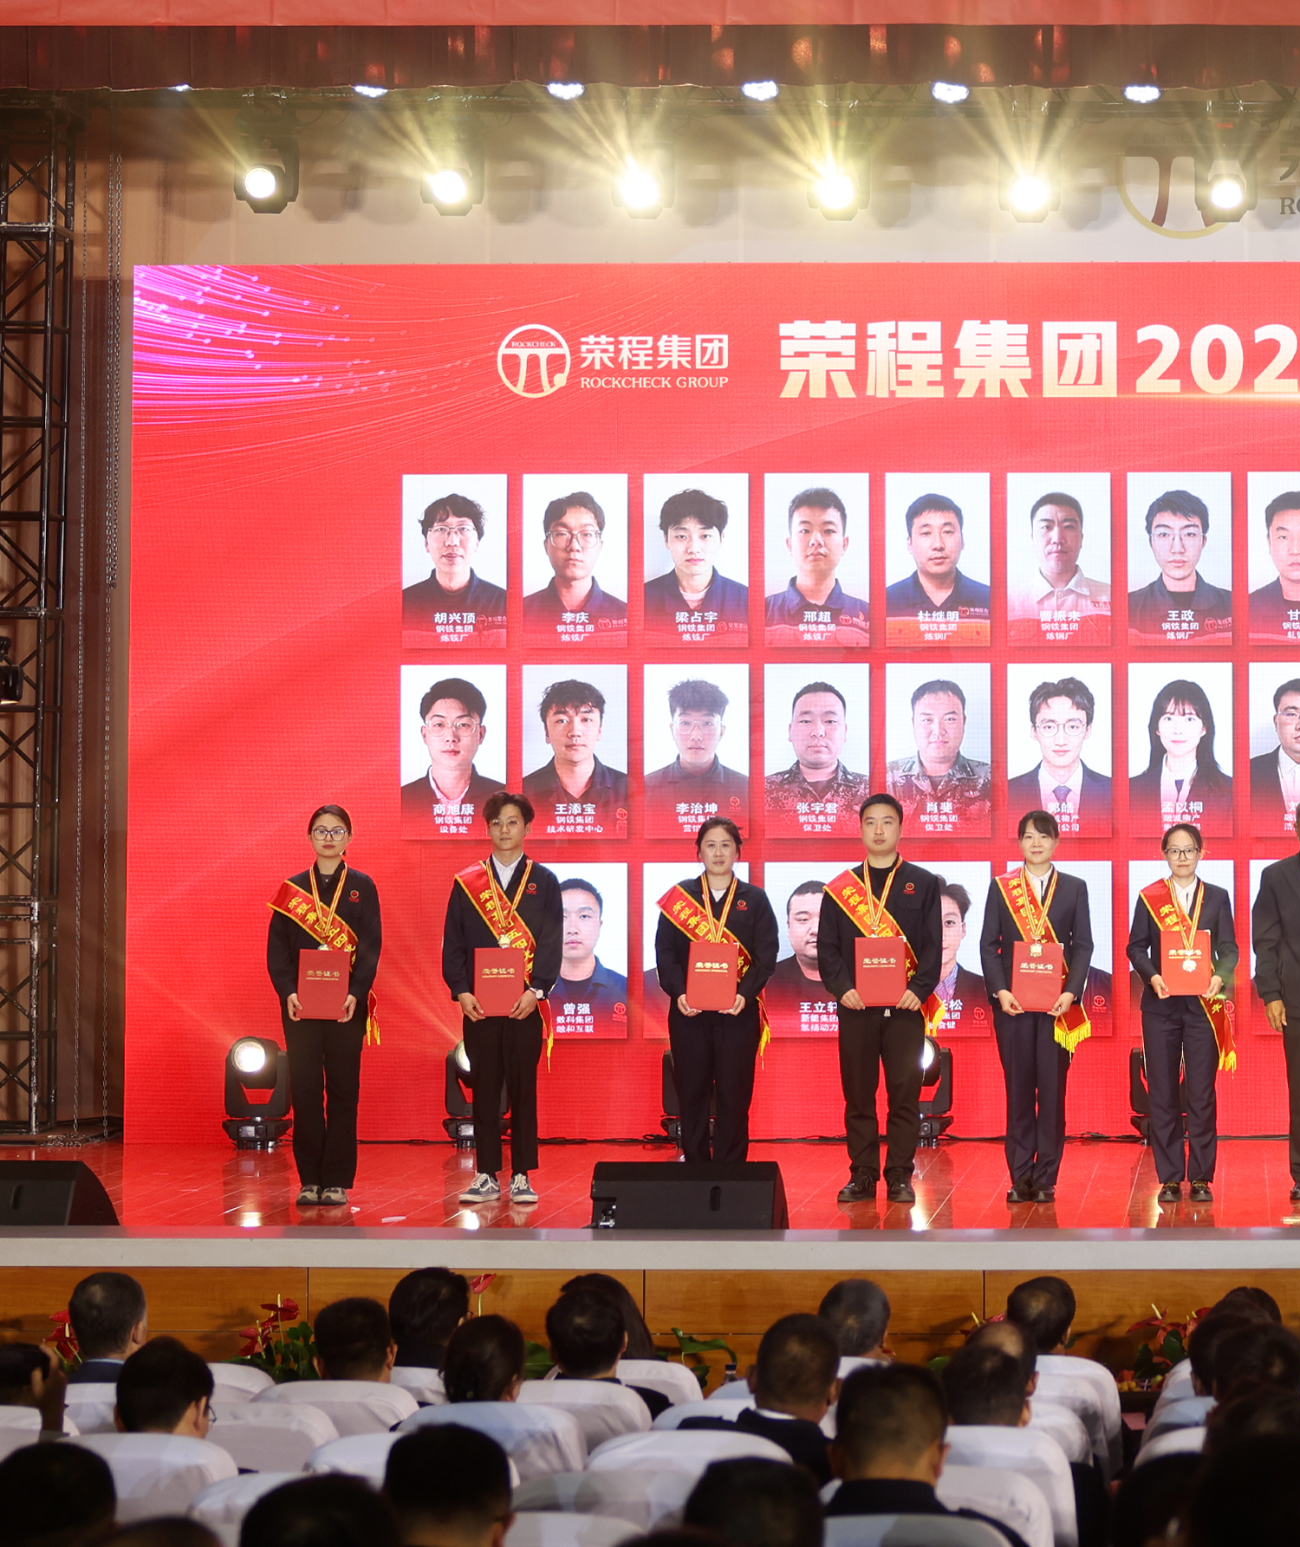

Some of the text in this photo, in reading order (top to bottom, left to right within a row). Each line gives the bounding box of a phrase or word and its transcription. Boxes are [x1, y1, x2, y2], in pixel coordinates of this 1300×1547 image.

[580, 334, 729, 370] 荣程集团
[580, 376, 729, 388] ROCKCHECK GROUP
[434, 614, 475, 625] 胡兴顶
[562, 612, 589, 624] 李庆
[1167, 610, 1194, 621] 王政
[436, 625, 473, 634] 钢铁集团
[557, 624, 594, 633] 钢铁集团
[678, 623, 716, 632] 钢铁集团
[800, 623, 836, 632] 钢铁集团
[920, 622, 958, 631] 钢铁集团
[1041, 622, 1078, 631] 钢铁集团
[1162, 621, 1199, 630] 钢铁集团
[676, 802, 717, 814] 李治坤
[798, 802, 838, 814] 张宇君
[1162, 800, 1202, 813] 孟以桐
[435, 815, 472, 824] 钢铁集团
[557, 815, 594, 824] 钢铁集团
[800, 814, 837, 823] 钢铁集团
[921, 813, 958, 822] 钢铁集团
[547, 824, 603, 832] 技术研发中心
[564, 1002, 590, 1014] 曾强
[800, 1014, 838, 1022] 新能集团
